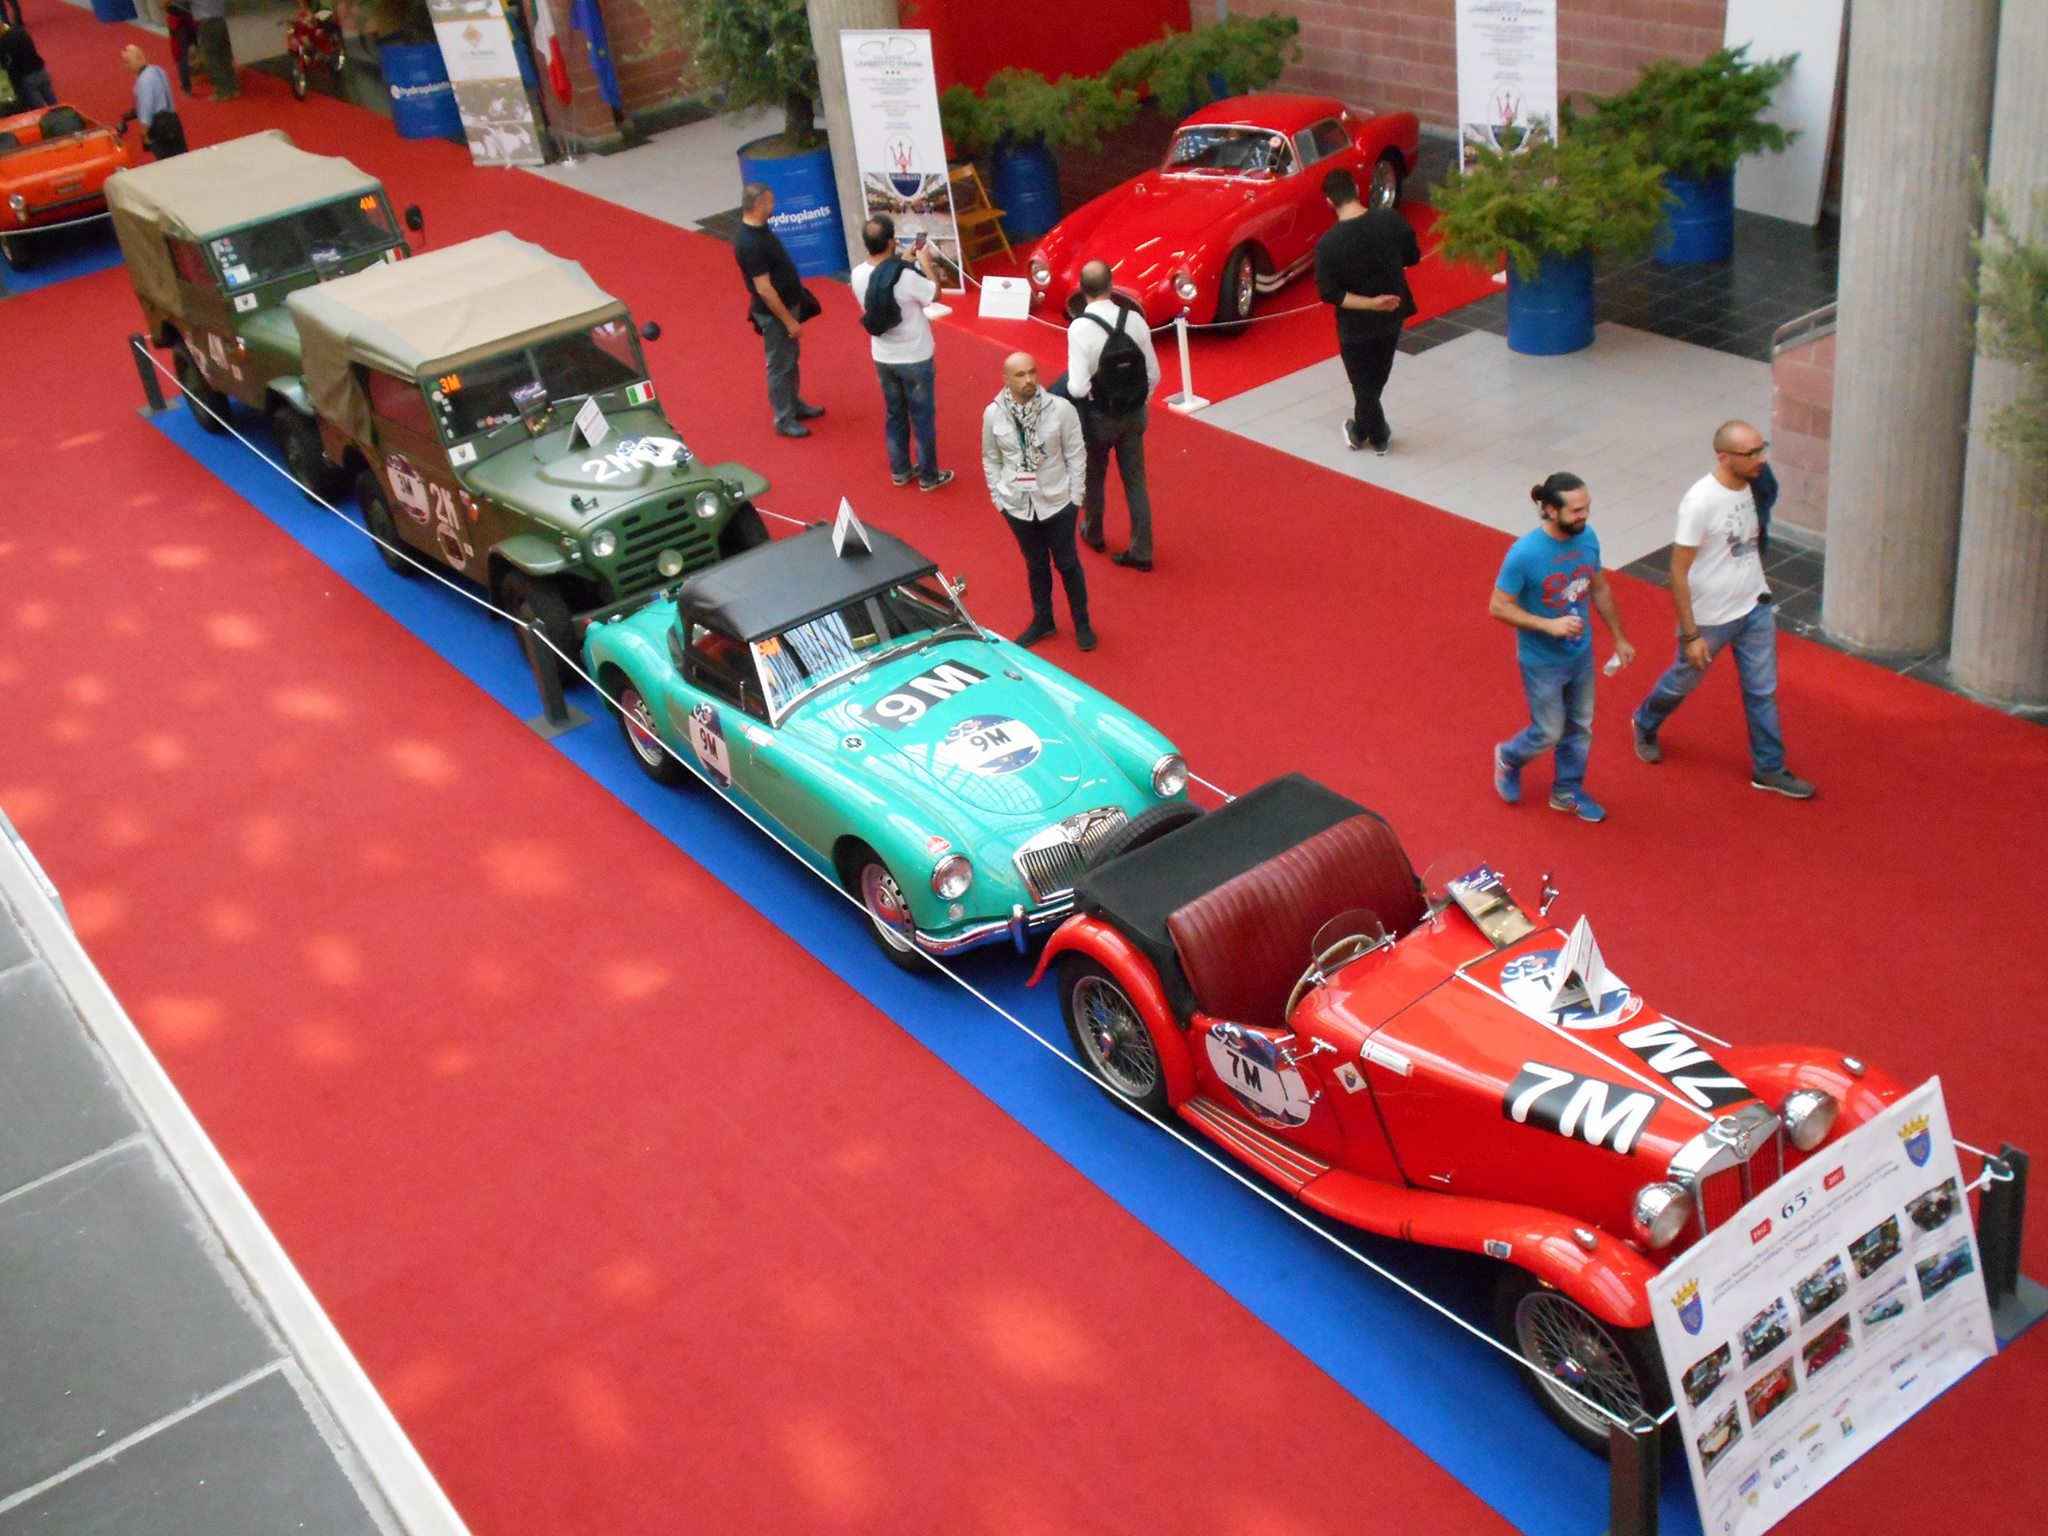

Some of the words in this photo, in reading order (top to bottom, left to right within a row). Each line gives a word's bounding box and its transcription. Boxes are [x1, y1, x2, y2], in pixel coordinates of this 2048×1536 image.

[875, 664, 982, 723] 9M
[699, 727, 719, 760] 9M
[969, 727, 1013, 752] 9M
[1226, 1049, 1263, 1093] 7M
[1511, 1061, 1656, 1155] 7M
